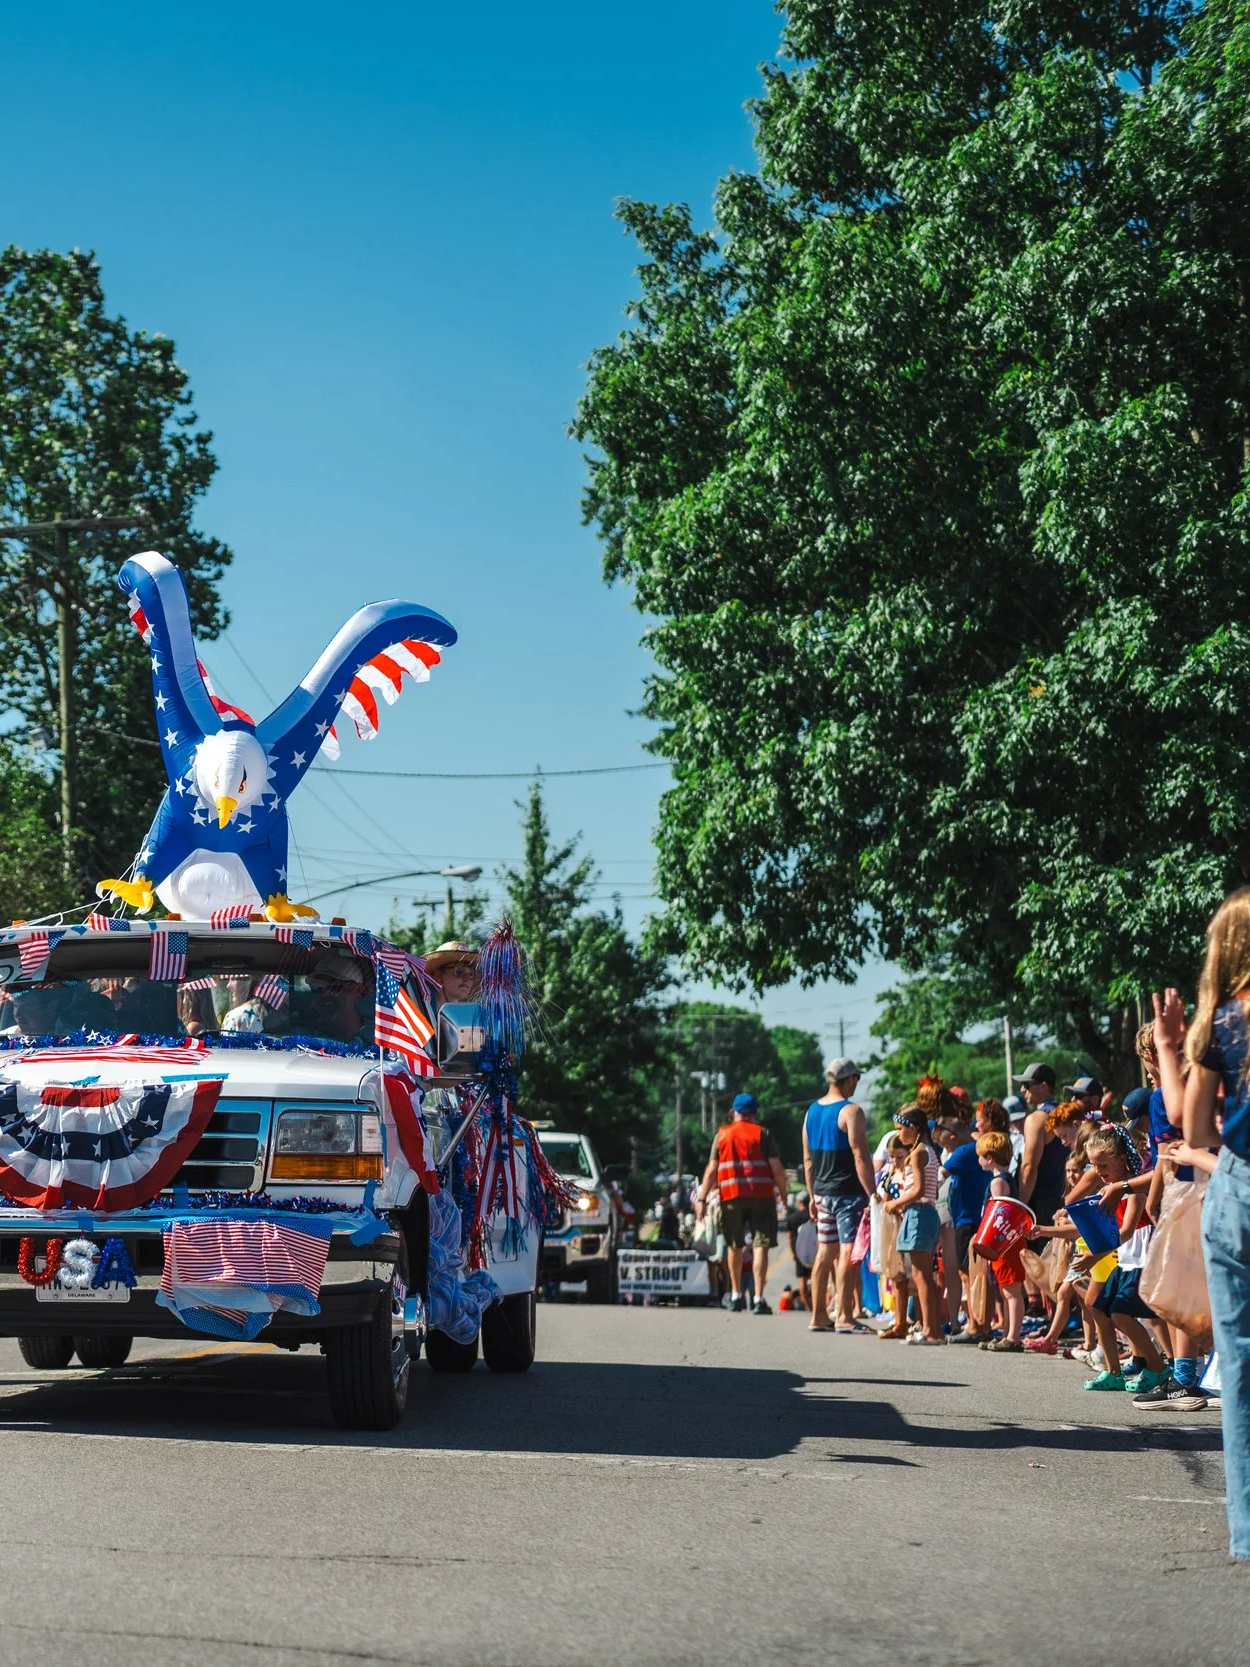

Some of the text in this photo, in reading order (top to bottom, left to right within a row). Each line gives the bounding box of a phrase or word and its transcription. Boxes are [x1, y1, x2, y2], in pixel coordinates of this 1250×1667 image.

[17, 1235, 137, 1288] USA
[635, 1266, 688, 1281] STROUT
[1167, 1389, 1188, 1399] HOKA
